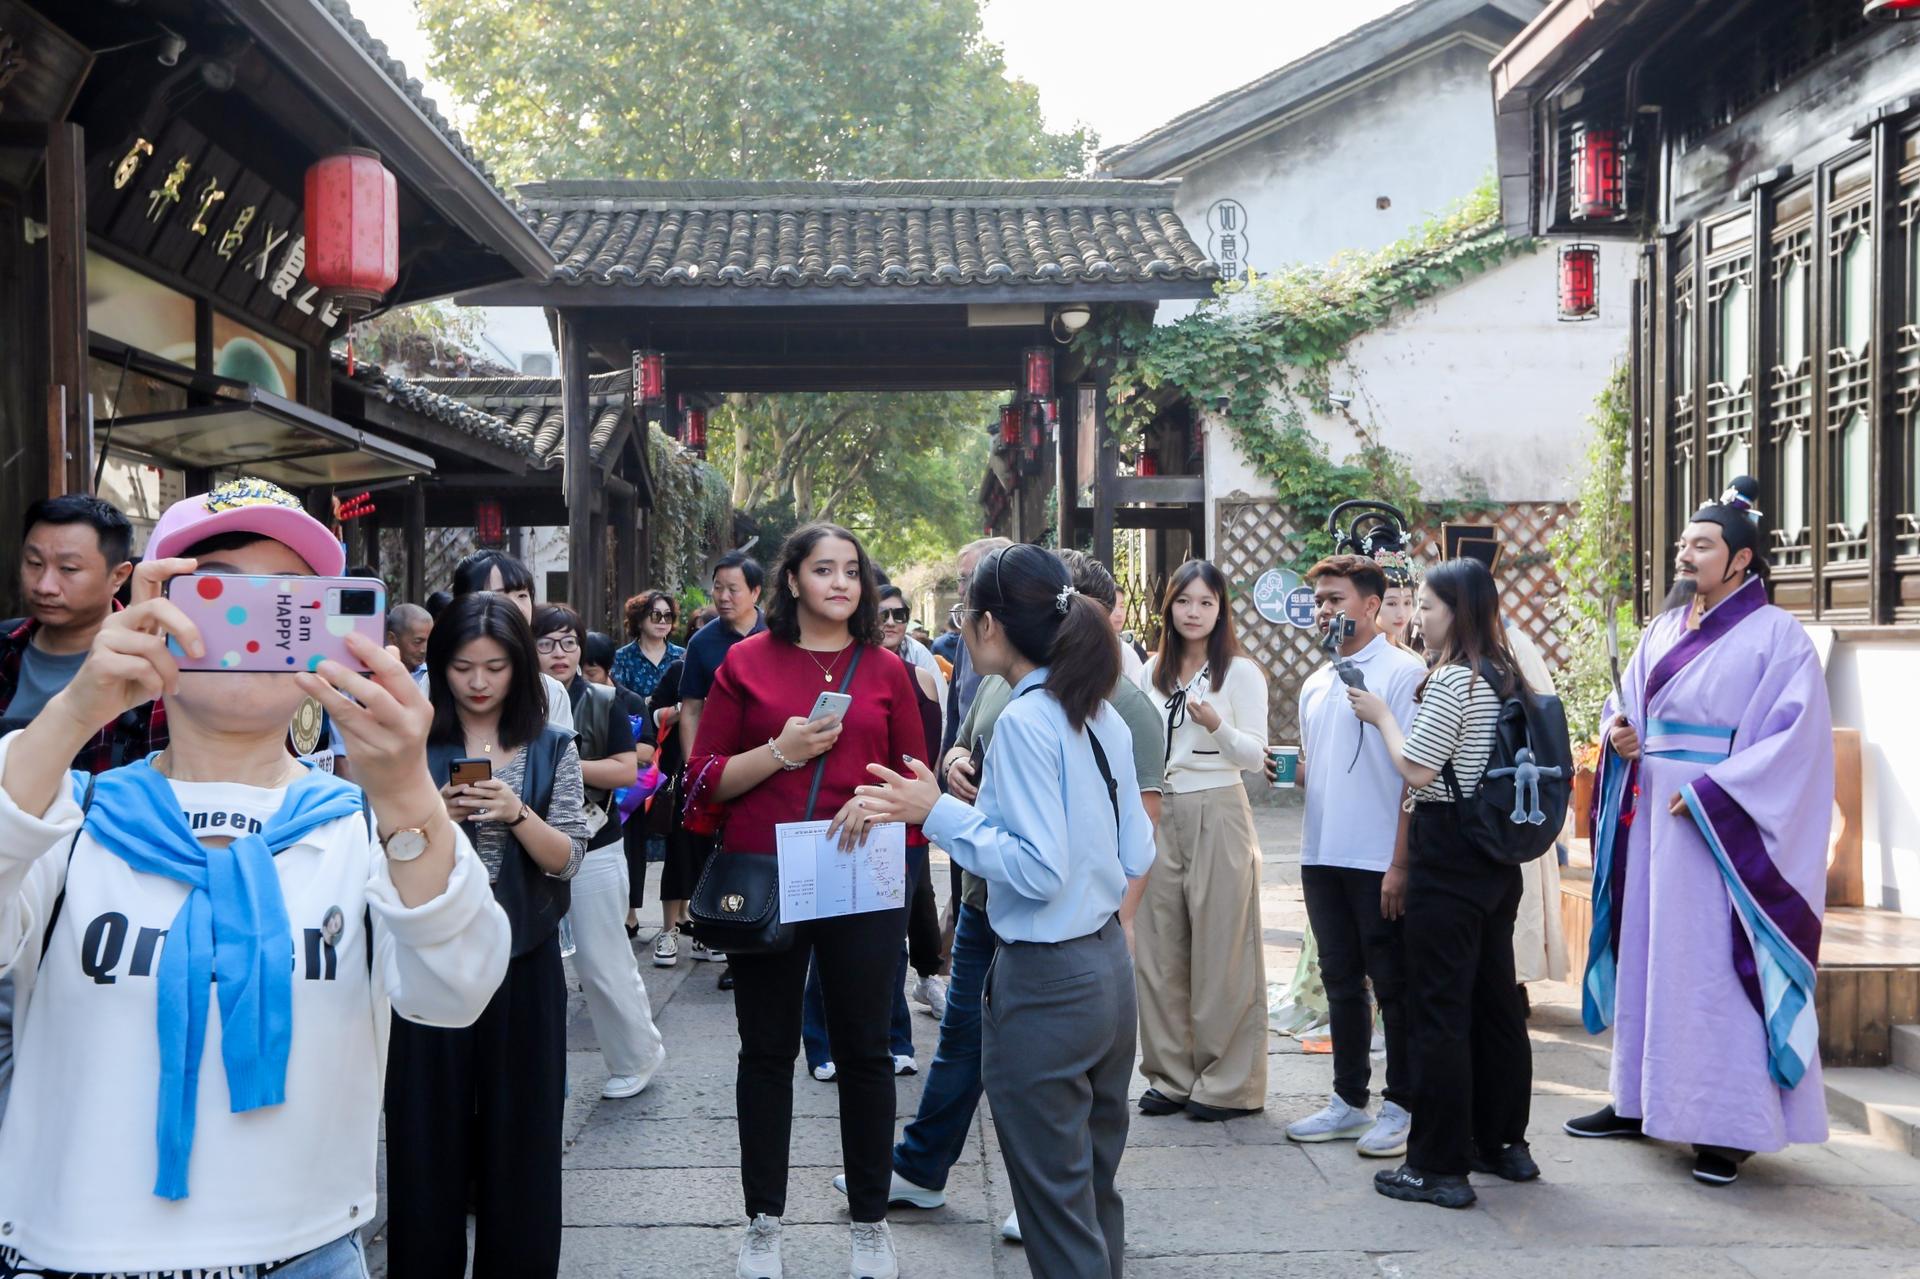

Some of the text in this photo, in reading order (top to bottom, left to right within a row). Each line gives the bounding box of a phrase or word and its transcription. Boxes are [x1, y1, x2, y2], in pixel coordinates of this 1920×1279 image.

[275, 594, 292, 651] HAPPY
[298, 615, 312, 642] am
[183, 811, 262, 834] neen
